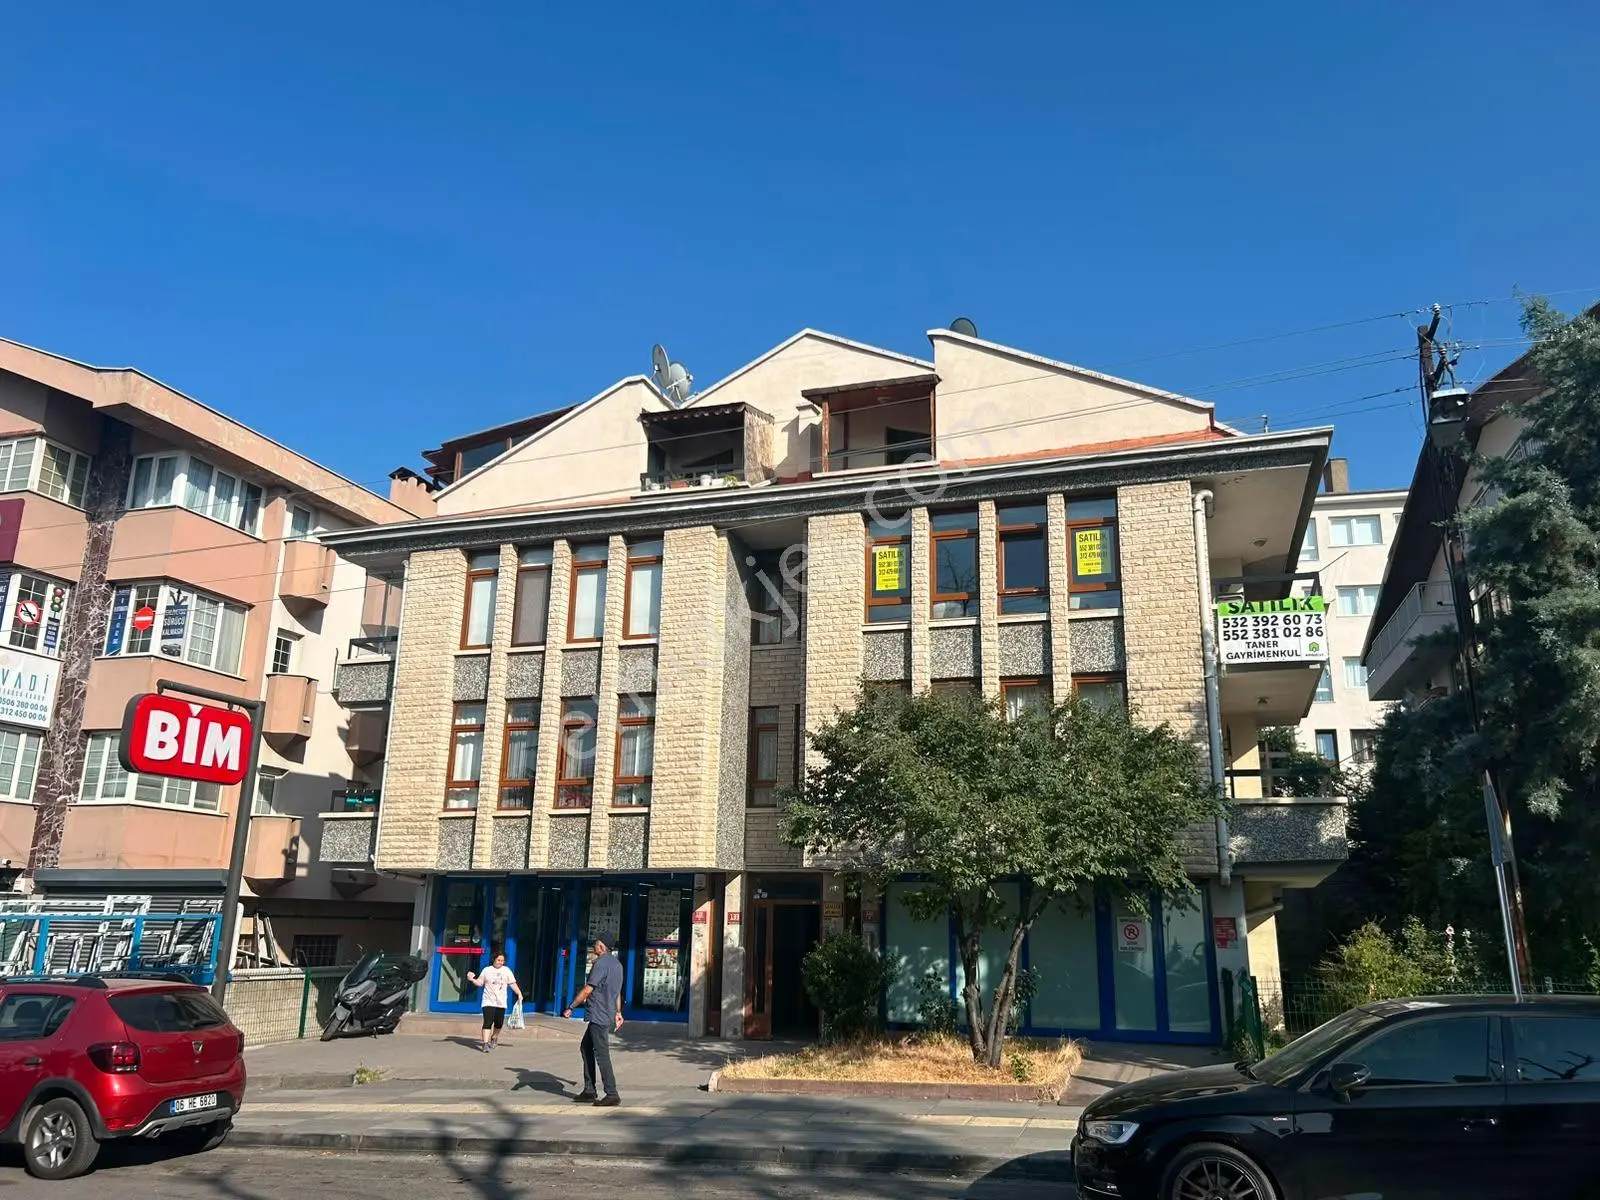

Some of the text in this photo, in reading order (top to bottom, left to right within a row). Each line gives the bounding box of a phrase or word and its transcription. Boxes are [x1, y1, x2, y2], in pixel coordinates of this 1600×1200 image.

[1222, 614, 1322, 628] 532 392 60 73
[1223, 627, 1324, 641] 552 381 02 86
[1245, 641, 1278, 649] TANER
[1226, 649, 1300, 660] GAYRİMENKUL
[1, 668, 49, 693] VADİ
[14, 710, 27, 718] 450
[143, 703, 242, 771] BİM
[176, 1100, 184, 1110] 06
[188, 1097, 196, 1108] HE
